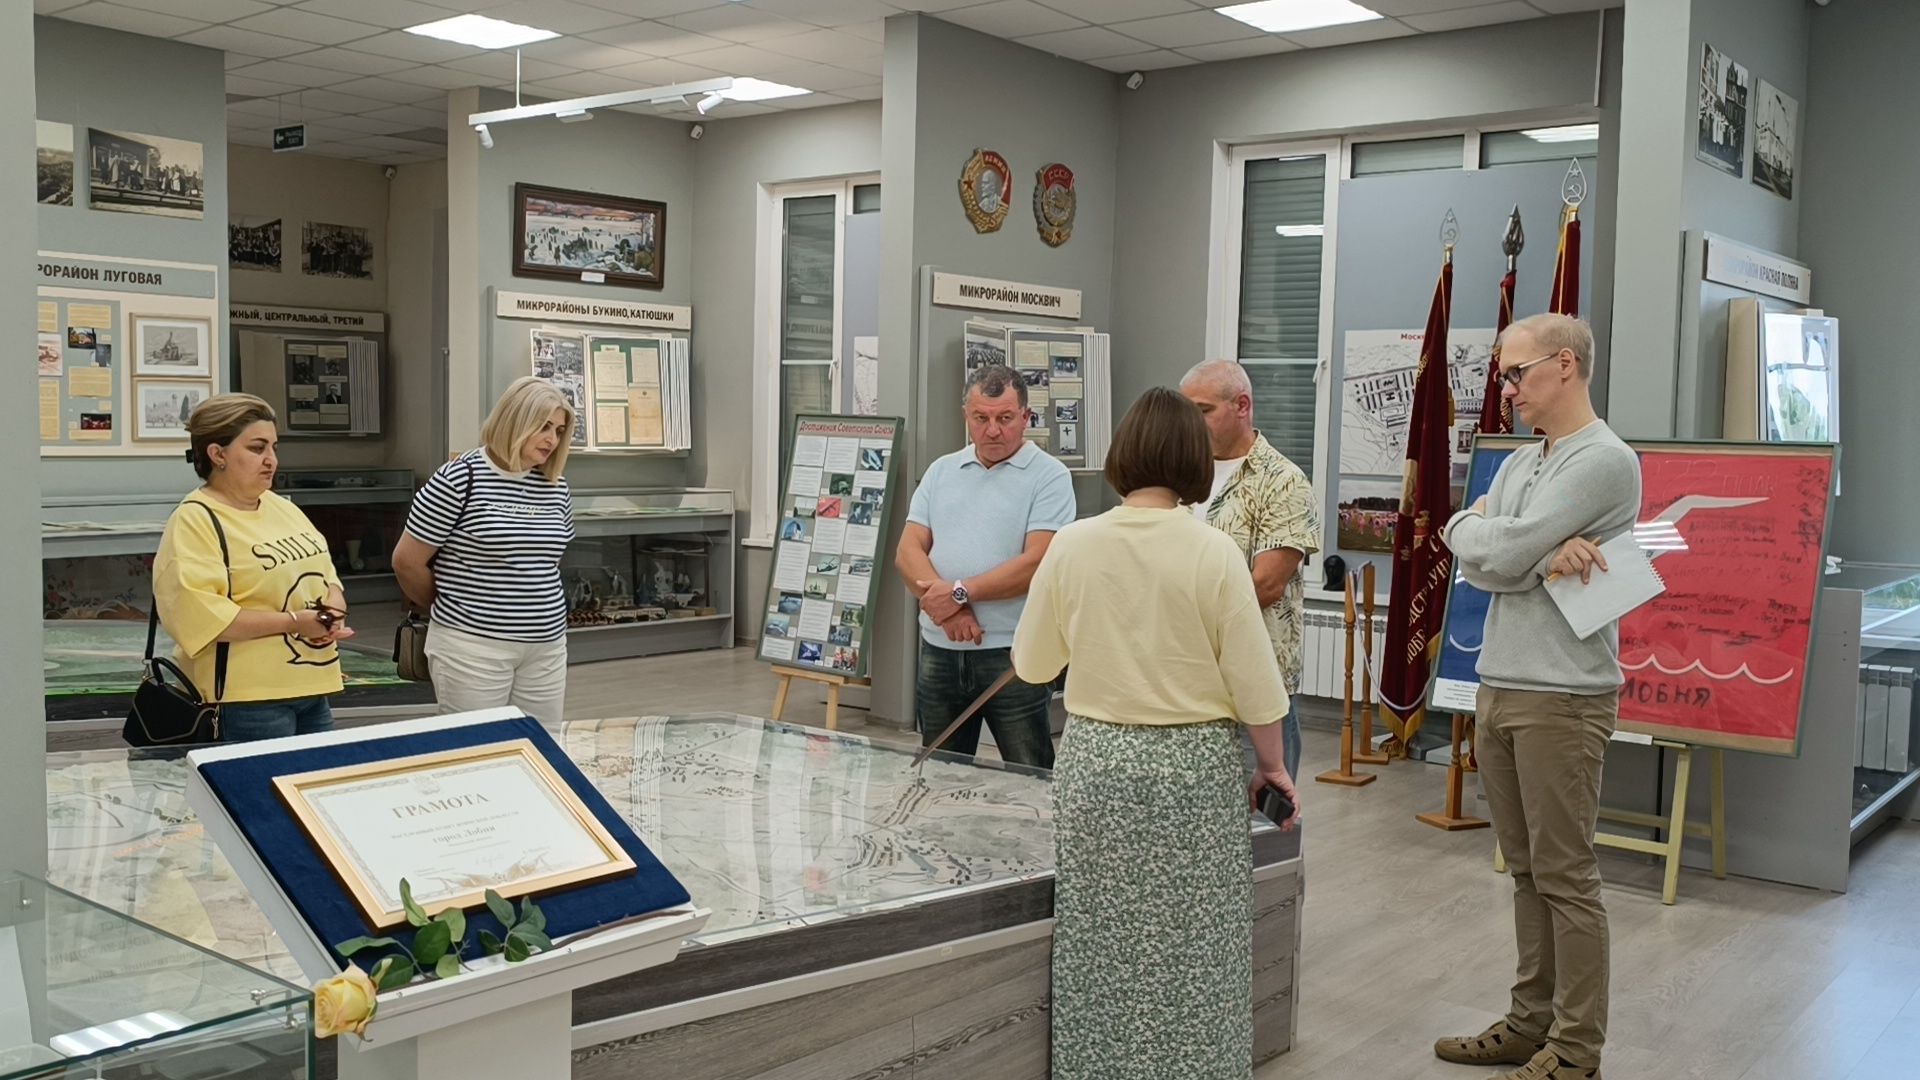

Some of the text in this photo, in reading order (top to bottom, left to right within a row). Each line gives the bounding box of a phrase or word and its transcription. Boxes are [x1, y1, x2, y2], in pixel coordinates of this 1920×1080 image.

[103, 270, 162, 286] ЛУГОВАЯ
[959, 284, 1061, 308] МИКРОРАЙОН МОСКВИЧ
[516, 299, 590, 316] МИКРОРАЙОНЫ
[333, 315, 364, 326] ТРЕТИЙ
[1619, 676, 1711, 708] ЛОБНЯ
[392, 792, 491, 819] ГРАМОТА
